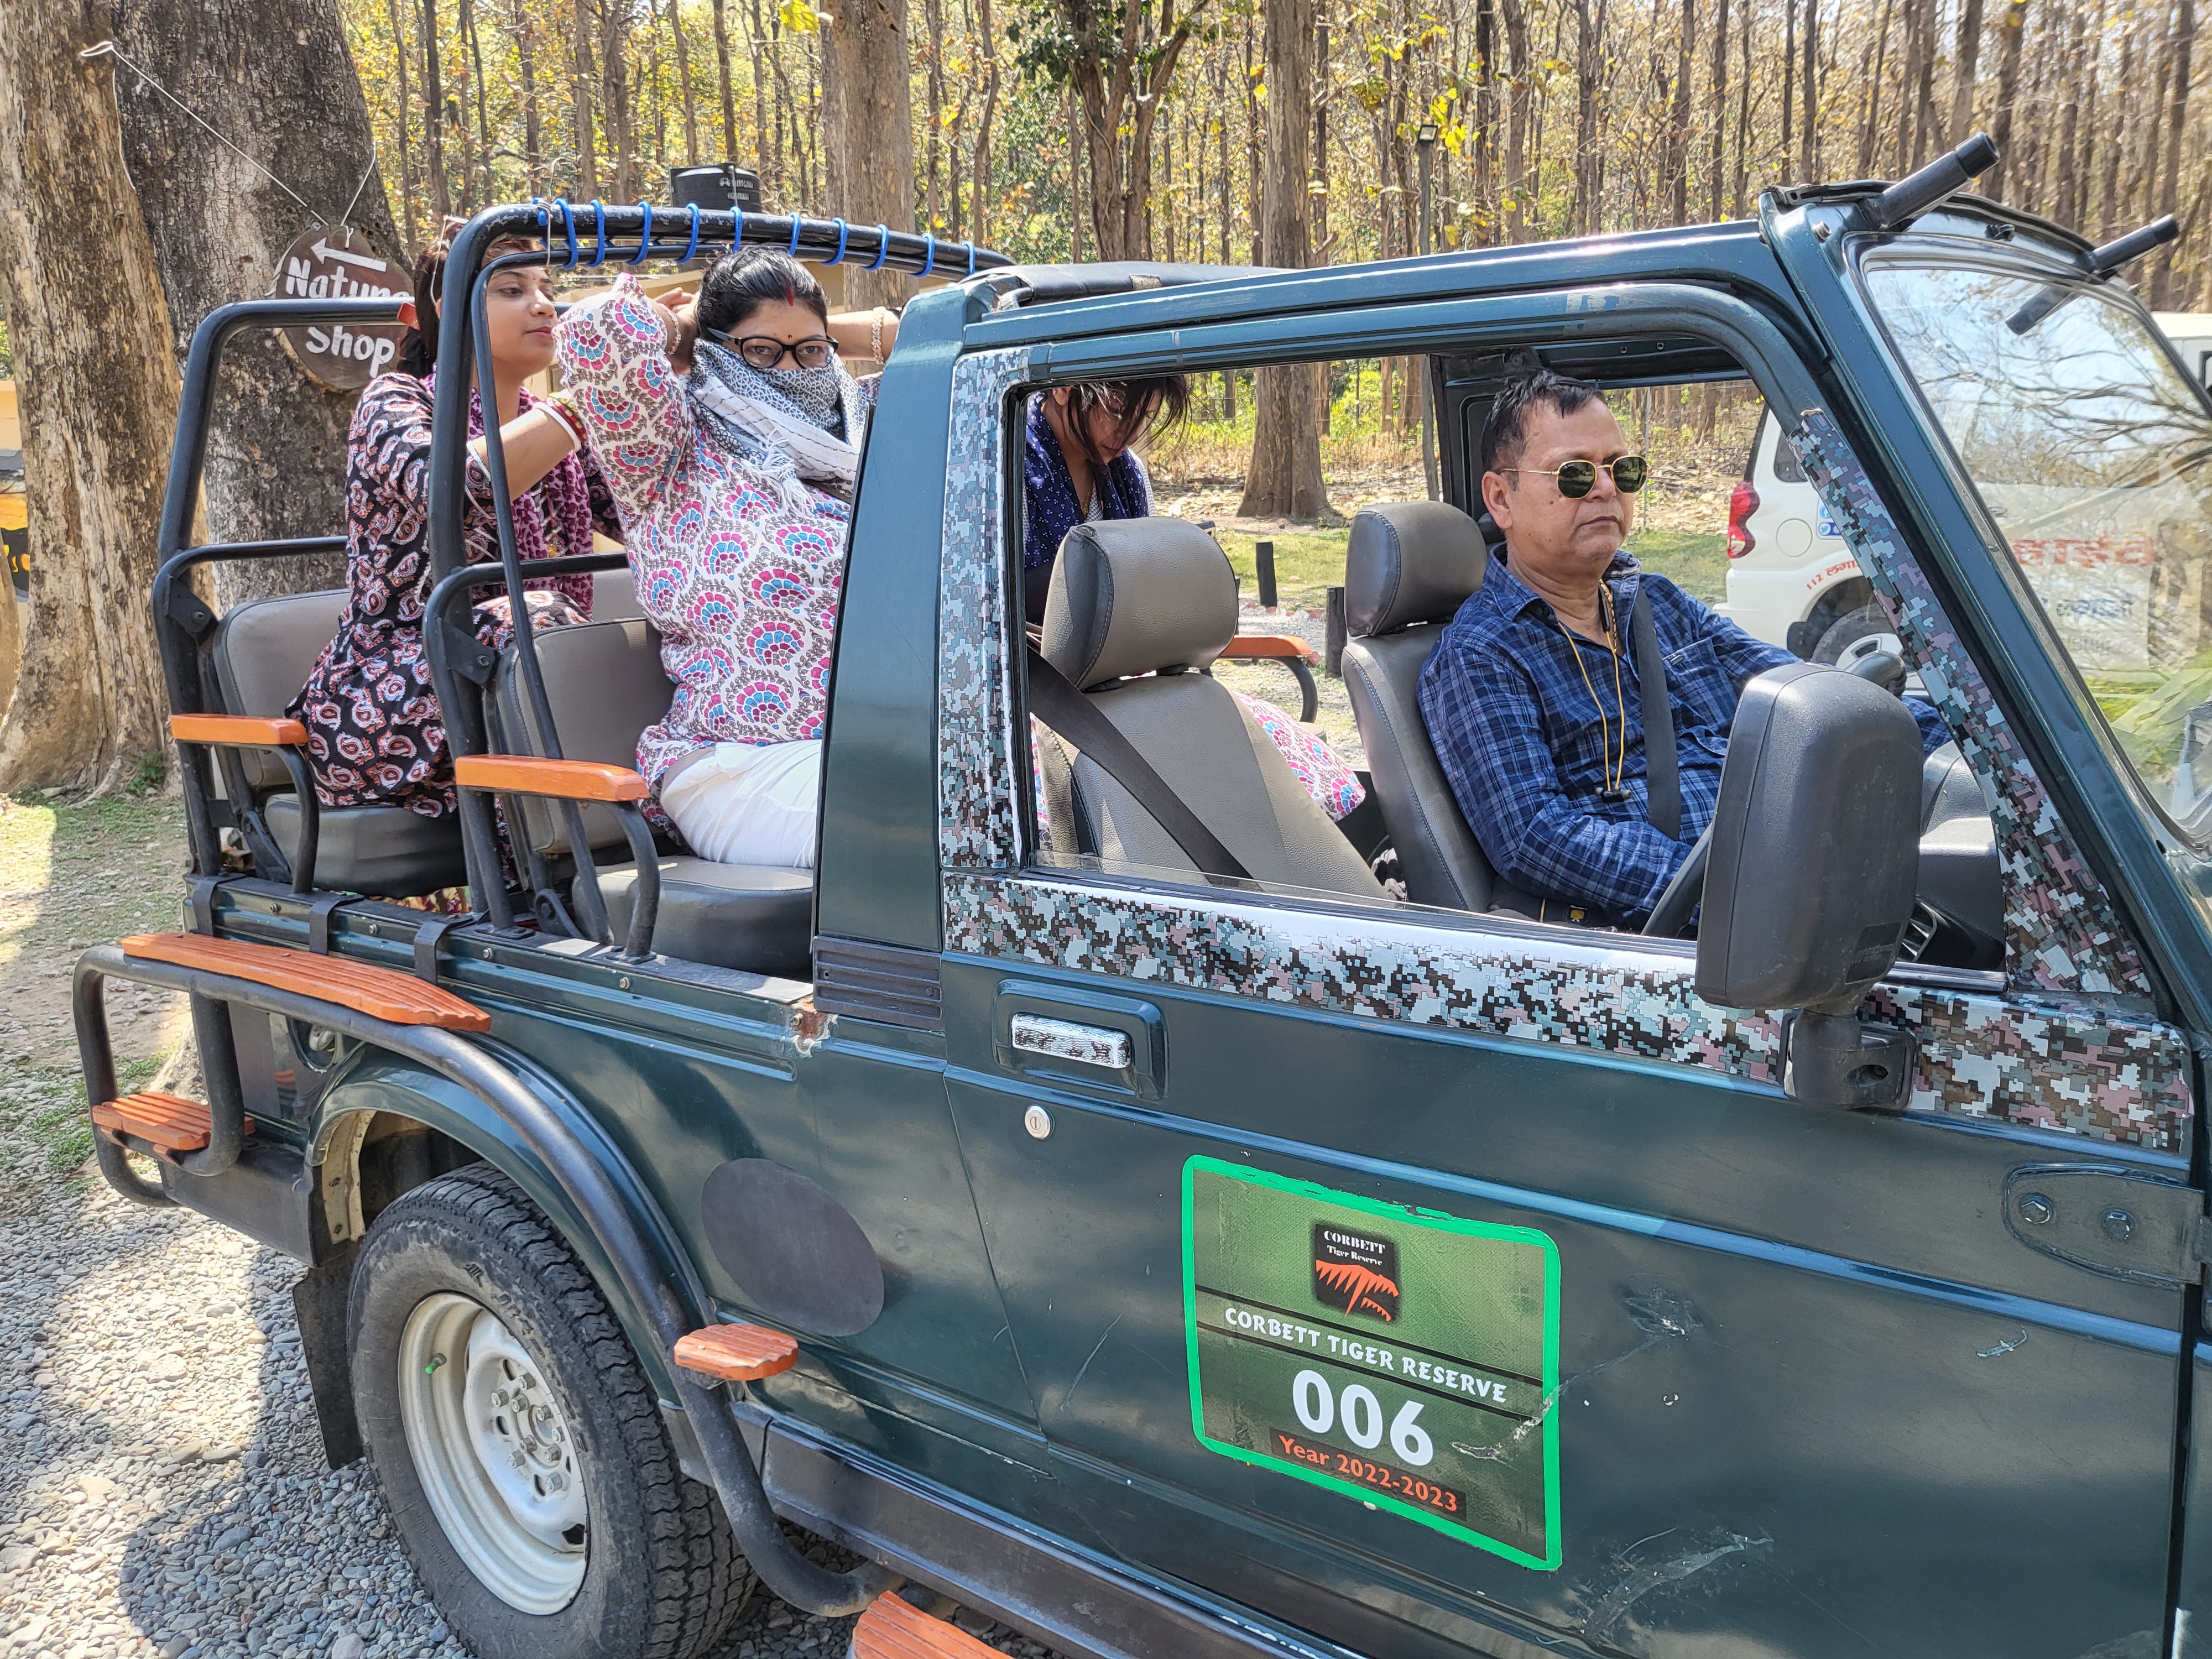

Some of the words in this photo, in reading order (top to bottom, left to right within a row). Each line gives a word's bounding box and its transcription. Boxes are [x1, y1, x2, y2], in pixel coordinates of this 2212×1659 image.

[306, 325, 395, 378] Shop
[1806, 574, 1823, 590] 112
[1324, 1230, 1385, 1254] CORBETT
[1327, 1245, 1349, 1257] Tiger
[1351, 1251, 1383, 1266] Reserve
[1225, 1308, 1321, 1347] CORBETT
[1327, 1335, 1394, 1370] TIGER
[1402, 1357, 1507, 1403] RESERVE
[1292, 1370, 1433, 1466] 006
[1279, 1434, 1329, 1465] Year
[1337, 1454, 1458, 1512] 2022-2023
